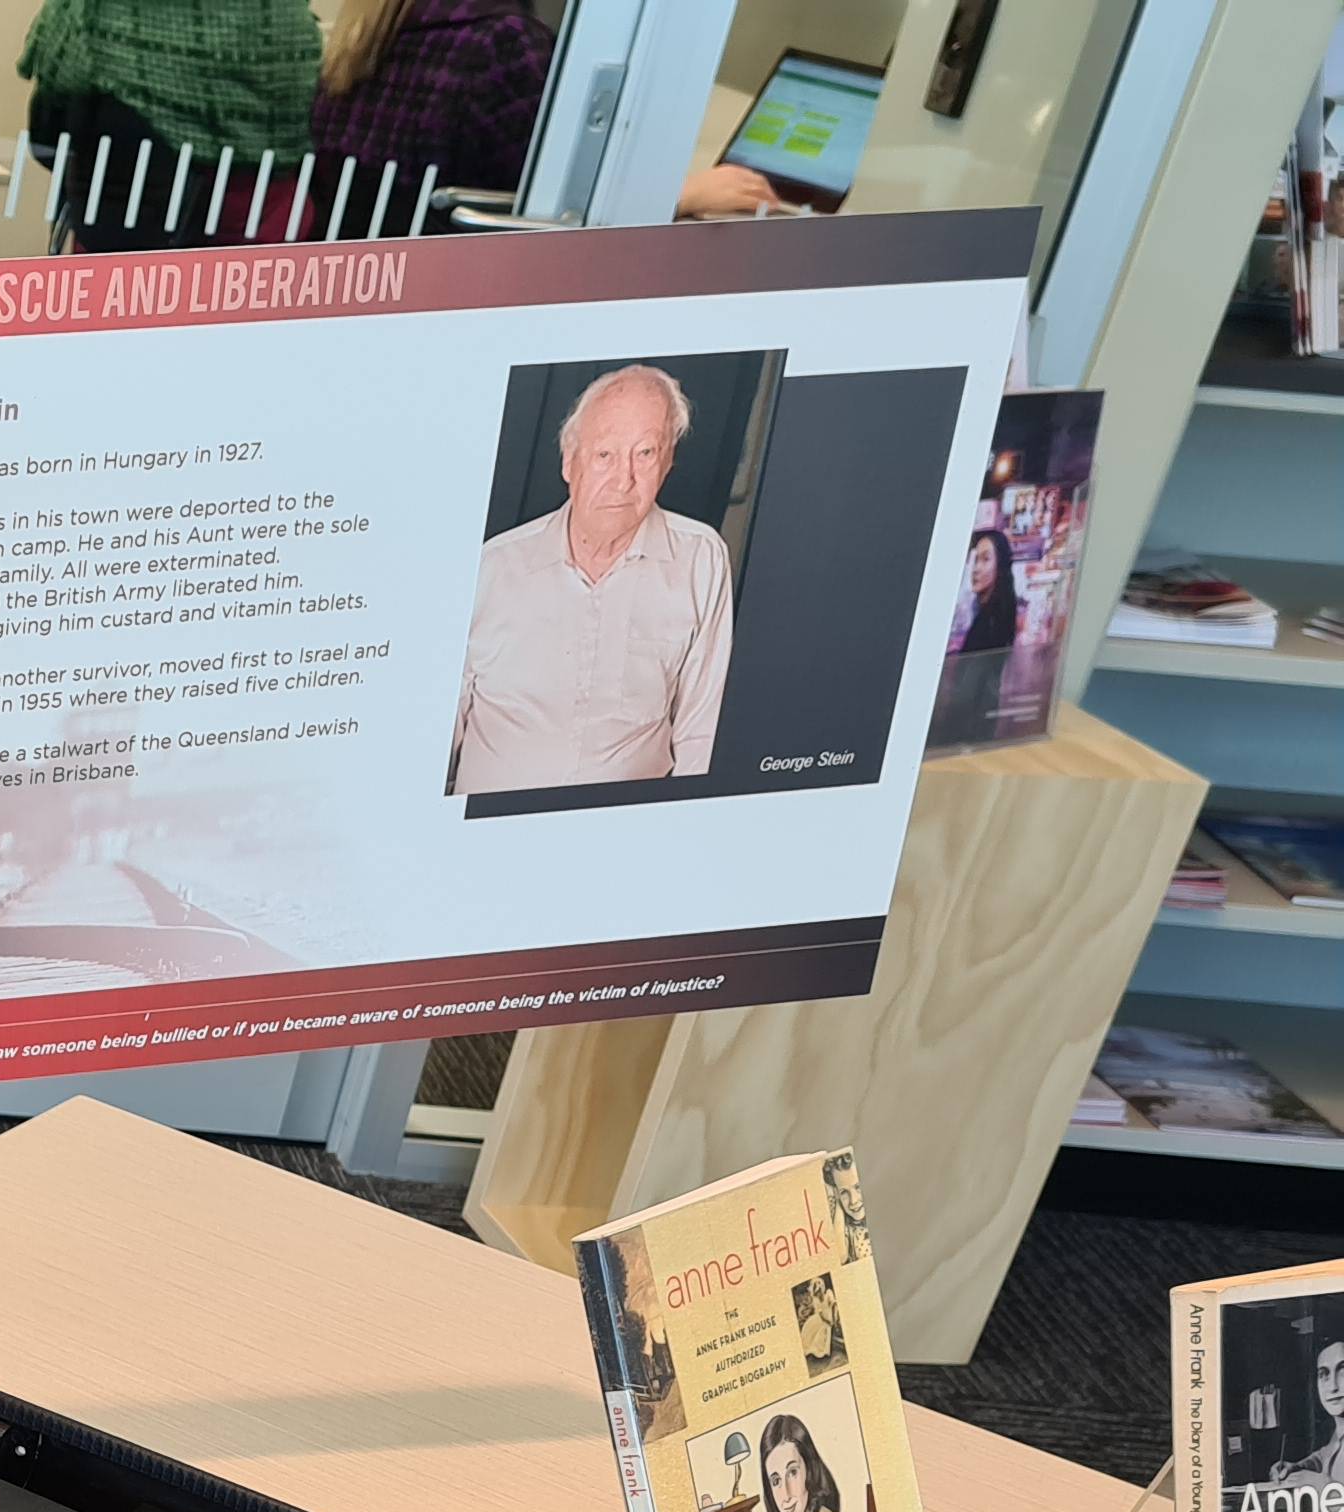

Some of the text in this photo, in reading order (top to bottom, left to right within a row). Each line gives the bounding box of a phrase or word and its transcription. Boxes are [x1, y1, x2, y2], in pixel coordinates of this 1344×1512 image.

[101, 264, 182, 319] AND
[188, 251, 406, 313] LIBERATION
[26, 456, 73, 475] born
[79, 452, 97, 472] in
[103, 450, 189, 471] Hungary
[194, 445, 211, 464] in
[218, 441, 263, 462] 1927.
[759, 749, 855, 773] George Stein
[22, 1037, 95, 1057] someone
[100, 1032, 147, 1049] being
[151, 1024, 208, 1044] bullied
[211, 1024, 230, 1038] or
[233, 1019, 247, 1036] if
[249, 1021, 280, 1037] you
[283, 1014, 347, 1032] became
[350, 1010, 398, 1025] aware
[402, 1003, 421, 1020] of
[423, 998, 496, 1018] someone
[498, 993, 545, 1011] being
[548, 989, 574, 1005] the
[579, 985, 626, 1002] victim
[629, 982, 651, 997] of
[650, 974, 725, 996] injustice?
[666, 1188, 830, 1309] anne frank
[724, 1308, 740, 1321] THE
[696, 1315, 777, 1357] ANNE FRANK HOUSE
[1190, 1303, 1205, 1390] Anne Frank
[715, 1344, 765, 1373] AUTHORIZED
[702, 1358, 787, 1403] GRAPHIC BIOGRAPHY
[1190, 1397, 1203, 1418] The
[613, 1406, 648, 1498] anne frank
[1188, 1420, 1203, 1453] Diary
[1192, 1455, 1203, 1468] of
[1192, 1469, 1200, 1480] a
